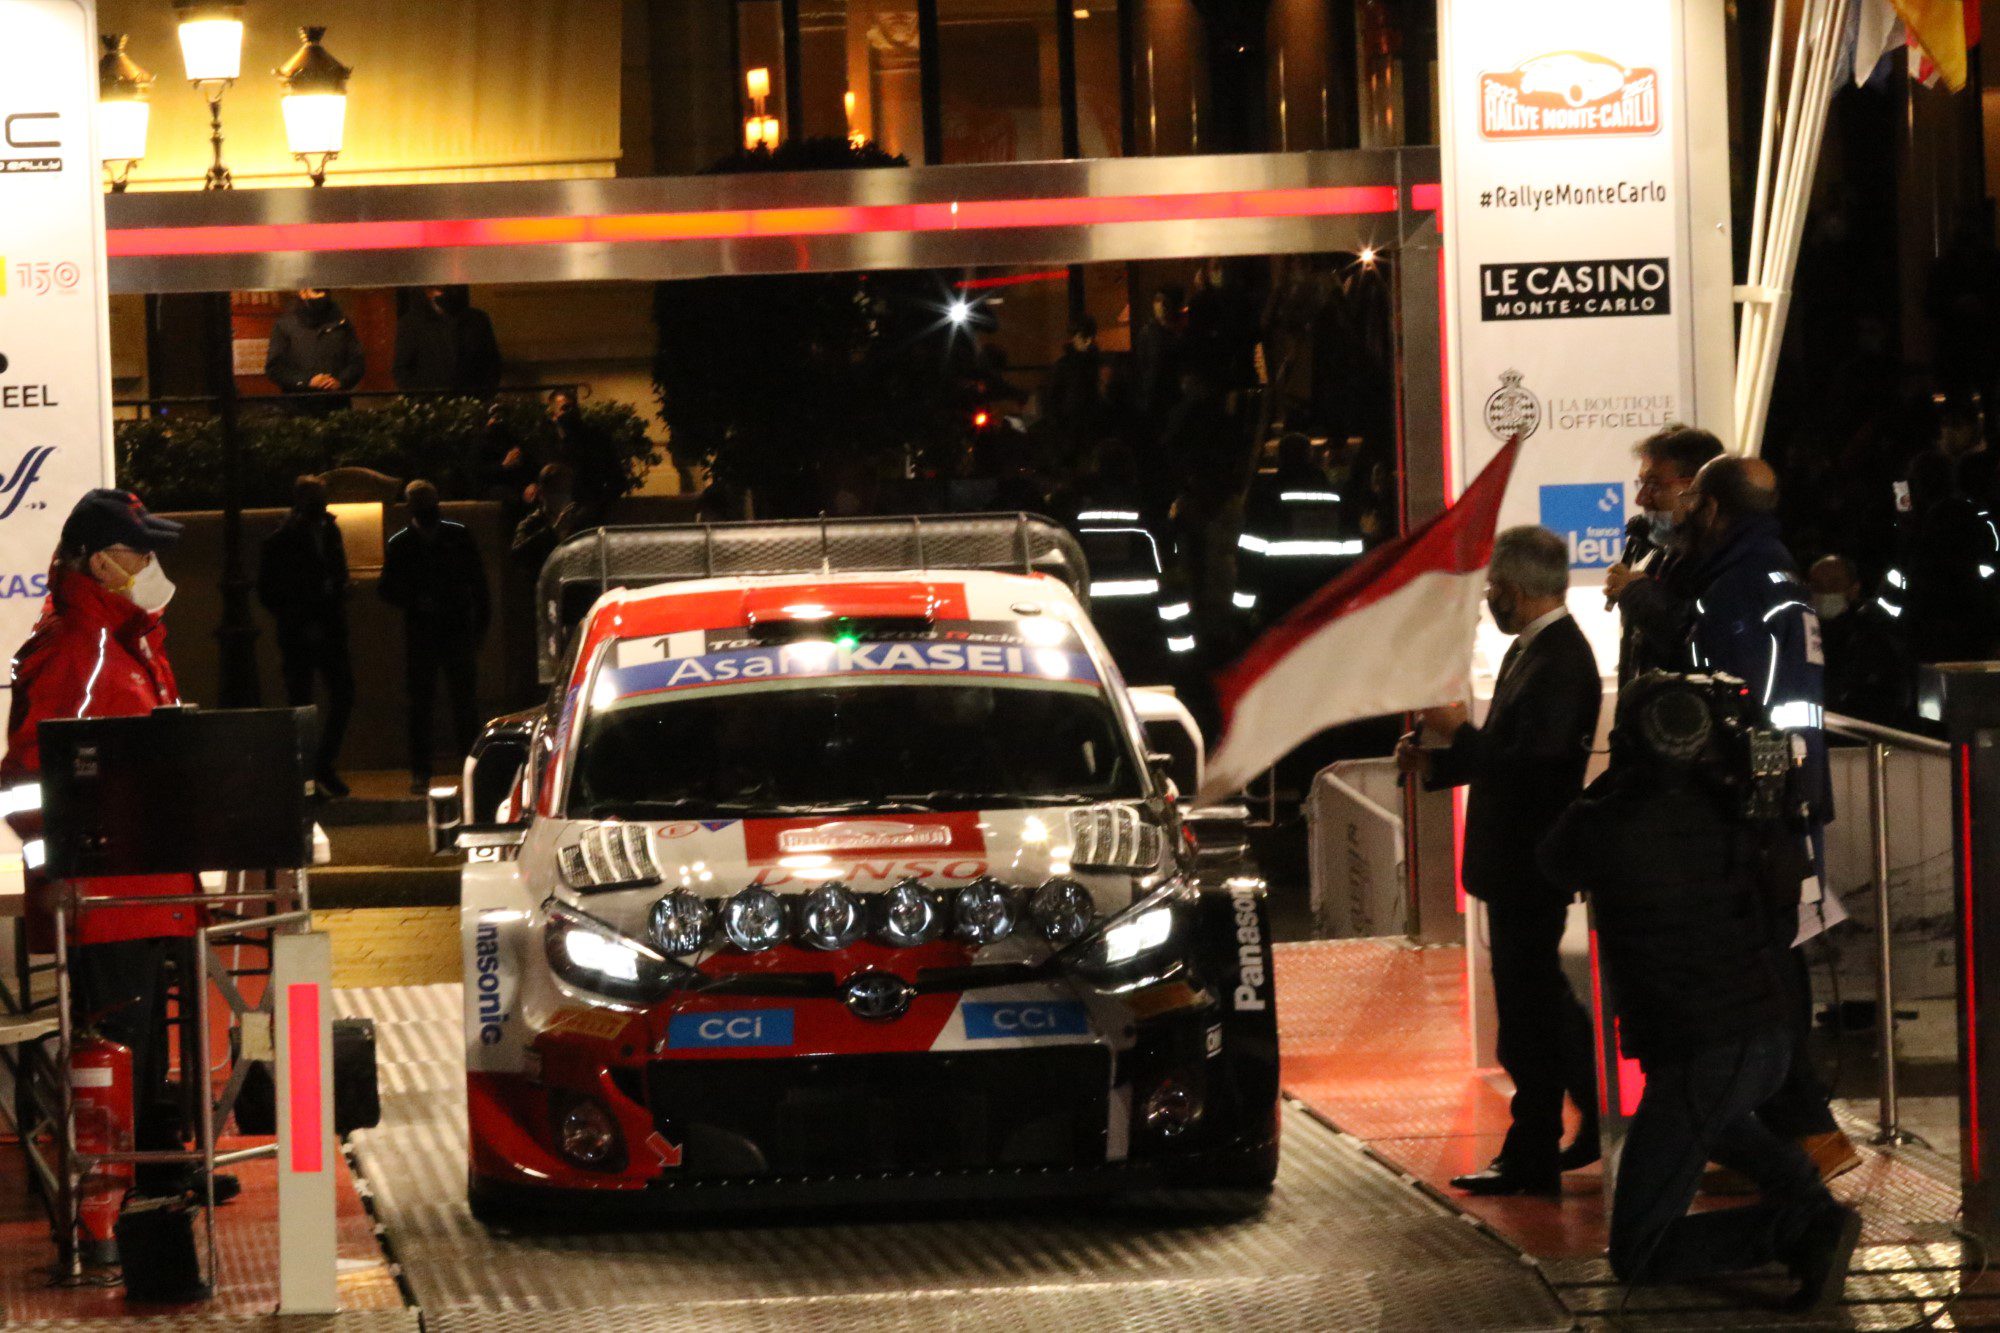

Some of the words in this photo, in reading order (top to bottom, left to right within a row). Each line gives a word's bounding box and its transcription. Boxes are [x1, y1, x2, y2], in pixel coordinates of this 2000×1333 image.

[1480, 181, 1667, 211] #RallyeMonteCarlo
[16, 261, 80, 296] 150
[1484, 269, 1519, 297] LE
[1526, 263, 1665, 295] CASINO
[1559, 399, 1578, 412] LA
[1583, 394, 1674, 412] BOUTIQUE
[1559, 411, 1675, 430] OFFICIELLE
[1586, 525, 1621, 538] france
[1567, 530, 1622, 564] leu
[652, 637, 671, 659] 1
[838, 643, 1023, 673] KASEI
[751, 860, 989, 887] DNSO
